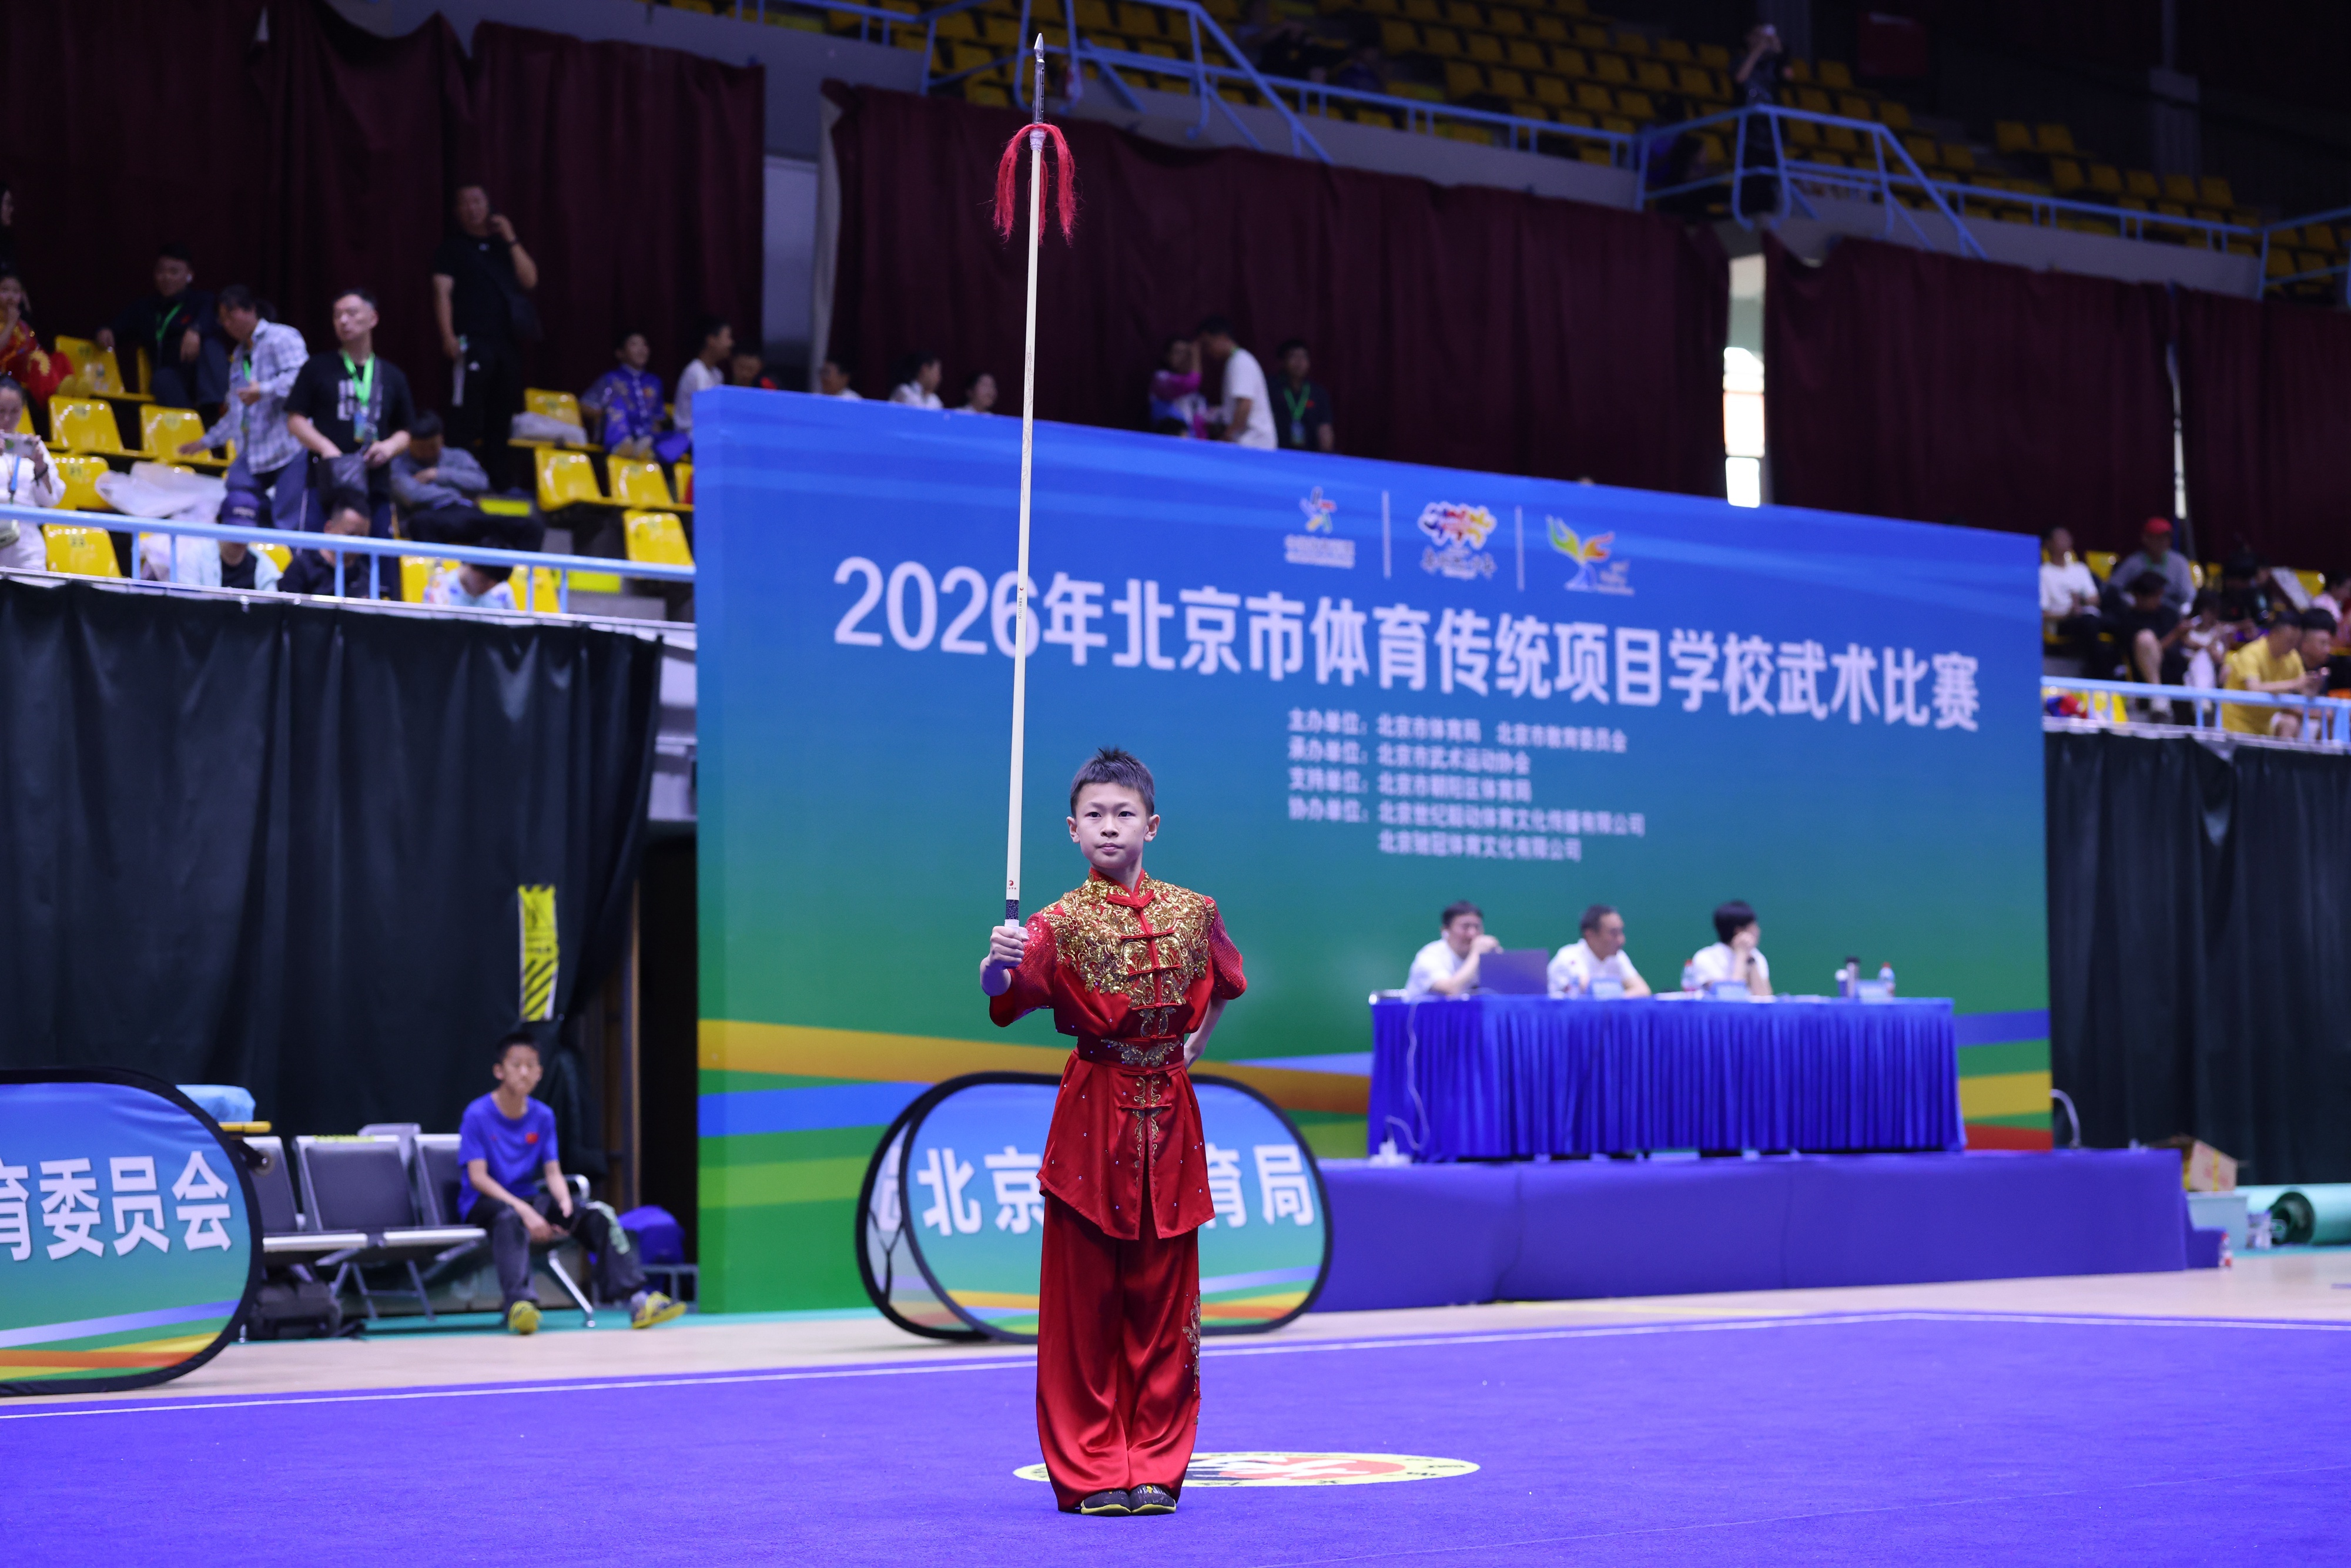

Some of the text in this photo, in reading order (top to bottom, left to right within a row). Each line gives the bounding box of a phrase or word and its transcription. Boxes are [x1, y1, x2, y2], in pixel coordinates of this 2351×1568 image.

[834, 557, 1979, 731] 2026年北京市体育传统项目学校武术比赛
[1377, 713, 1481, 743] 北京市体育局
[917, 1144, 1314, 1235] 北京育局
